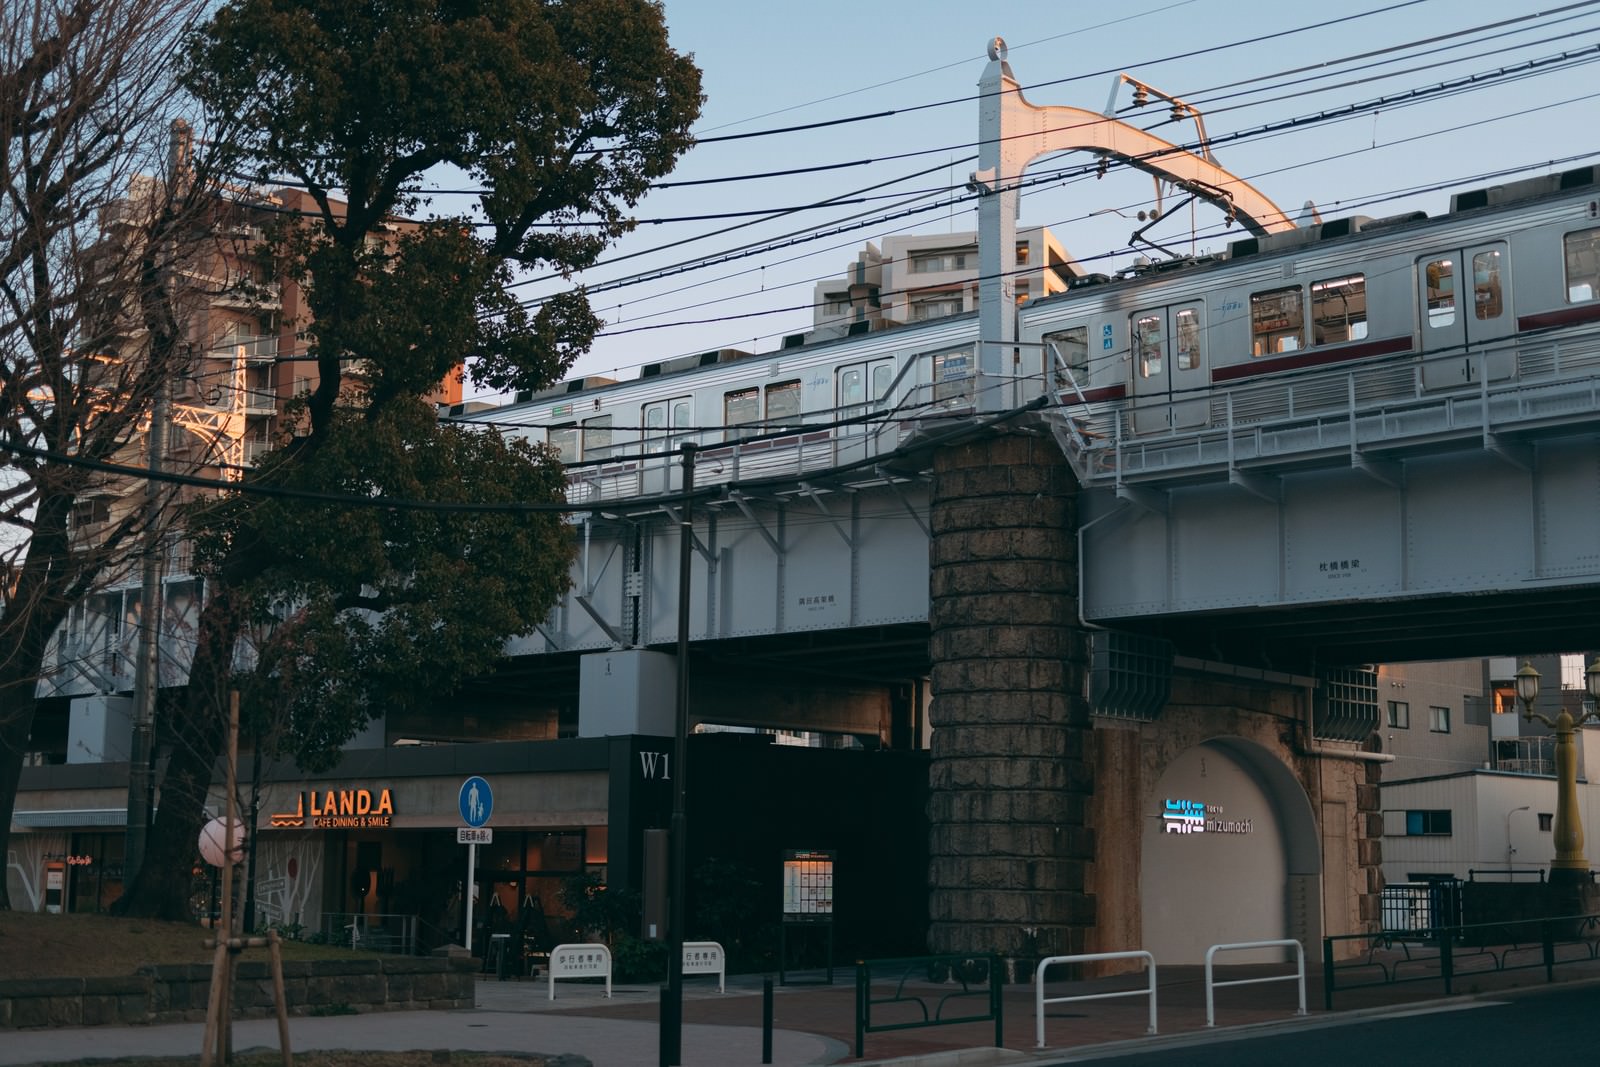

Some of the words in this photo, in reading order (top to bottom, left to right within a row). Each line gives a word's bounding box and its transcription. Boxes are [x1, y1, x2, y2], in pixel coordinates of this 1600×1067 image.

[640, 751, 671, 780] W1
[1207, 805, 1223, 814] TOKYO
[313, 817, 331, 828] CAFE
[333, 816, 359, 828] DINING
[360, 816, 366, 827] &
[367, 815, 390, 827] SMILE
[1207, 819, 1254, 834] mizumachi
[461, 830, 490, 842] 自転車を除く
